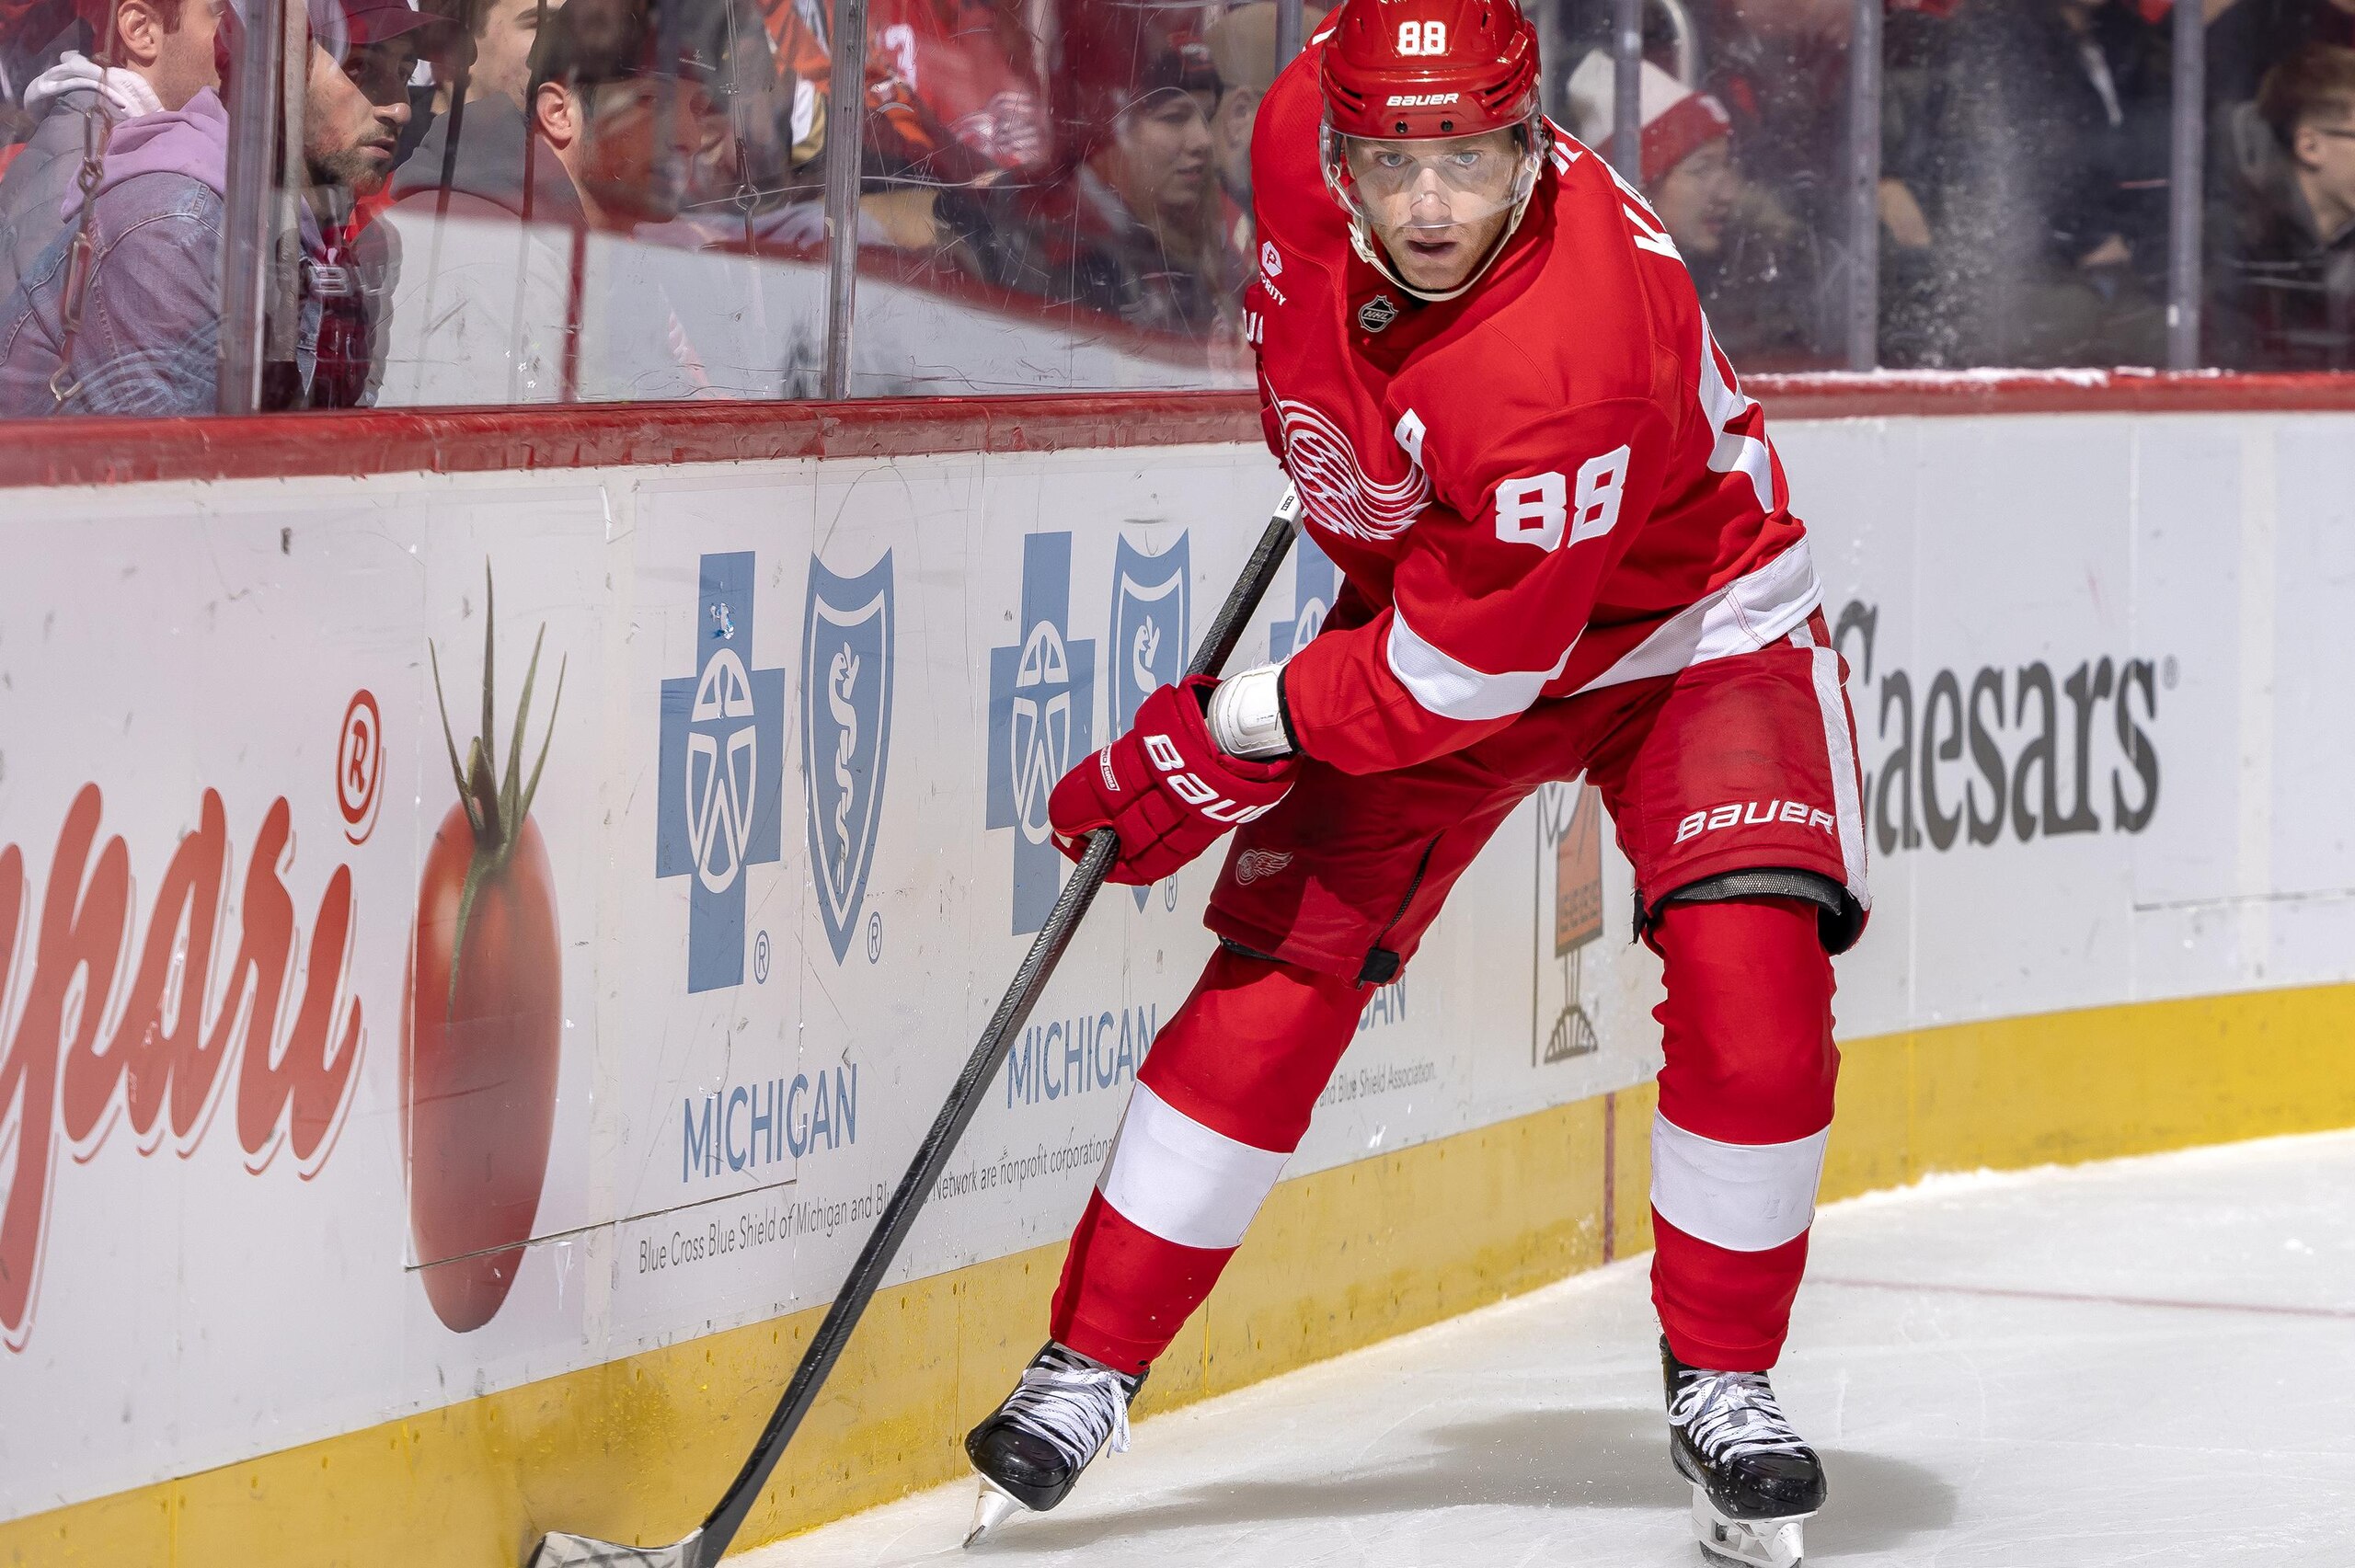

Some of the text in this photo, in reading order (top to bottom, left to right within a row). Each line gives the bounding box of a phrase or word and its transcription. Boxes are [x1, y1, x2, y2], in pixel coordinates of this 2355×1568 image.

[1398, 20, 1446, 55] 88
[1386, 93, 1460, 107] BAUER
[1363, 310, 1391, 320] NHL
[1495, 444, 1630, 553] 88
[1143, 734, 1281, 824] BAU
[1674, 797, 1835, 844] BAUER
[0, 781, 365, 1345] pari
[1007, 1002, 1155, 1109] MICHIGAN
[1338, 1072, 1357, 1103] Blue
[1360, 1063, 1385, 1098] Shield
[683, 1063, 858, 1183] MICHIGAN
[638, 1236, 666, 1274] Blue
[671, 1231, 705, 1266] Cross
[708, 1219, 735, 1256] Blue
[739, 1207, 776, 1249] Shield
[779, 1203, 796, 1238] of
[796, 1197, 847, 1238] Michigan
[850, 1184, 872, 1222] and
[933, 1160, 978, 1201] Network
[981, 1165, 996, 1190] are
[1000, 1143, 1047, 1192] nonprofit
